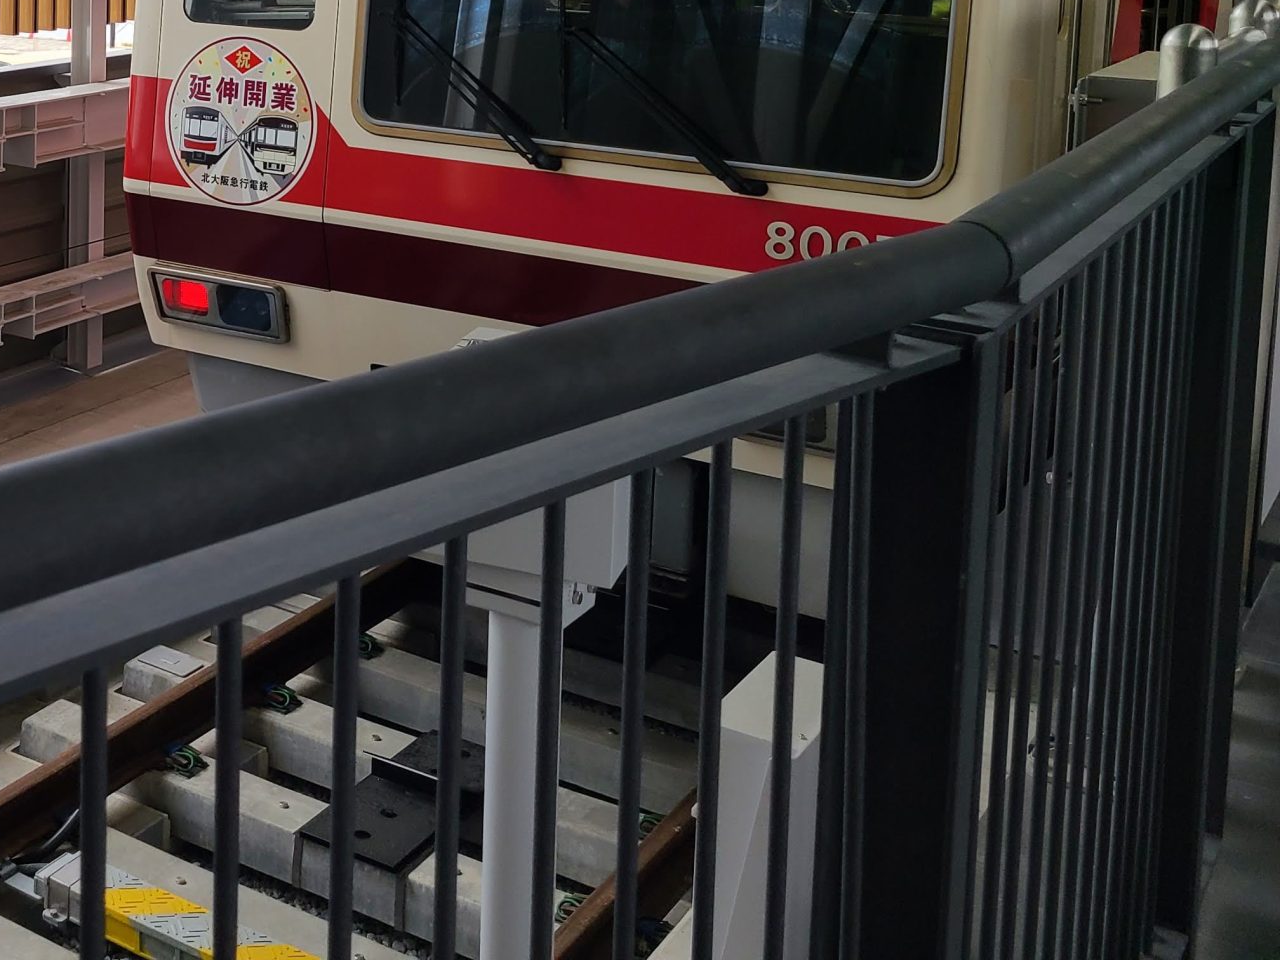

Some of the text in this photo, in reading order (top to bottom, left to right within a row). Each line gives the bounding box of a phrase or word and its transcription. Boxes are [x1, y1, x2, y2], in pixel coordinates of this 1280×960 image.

[235, 50, 251, 69] 祝
[188, 74, 297, 112] 延伸開業
[201, 172, 268, 192] 北大阪急行電鉄
[765, 221, 895, 260] 80
